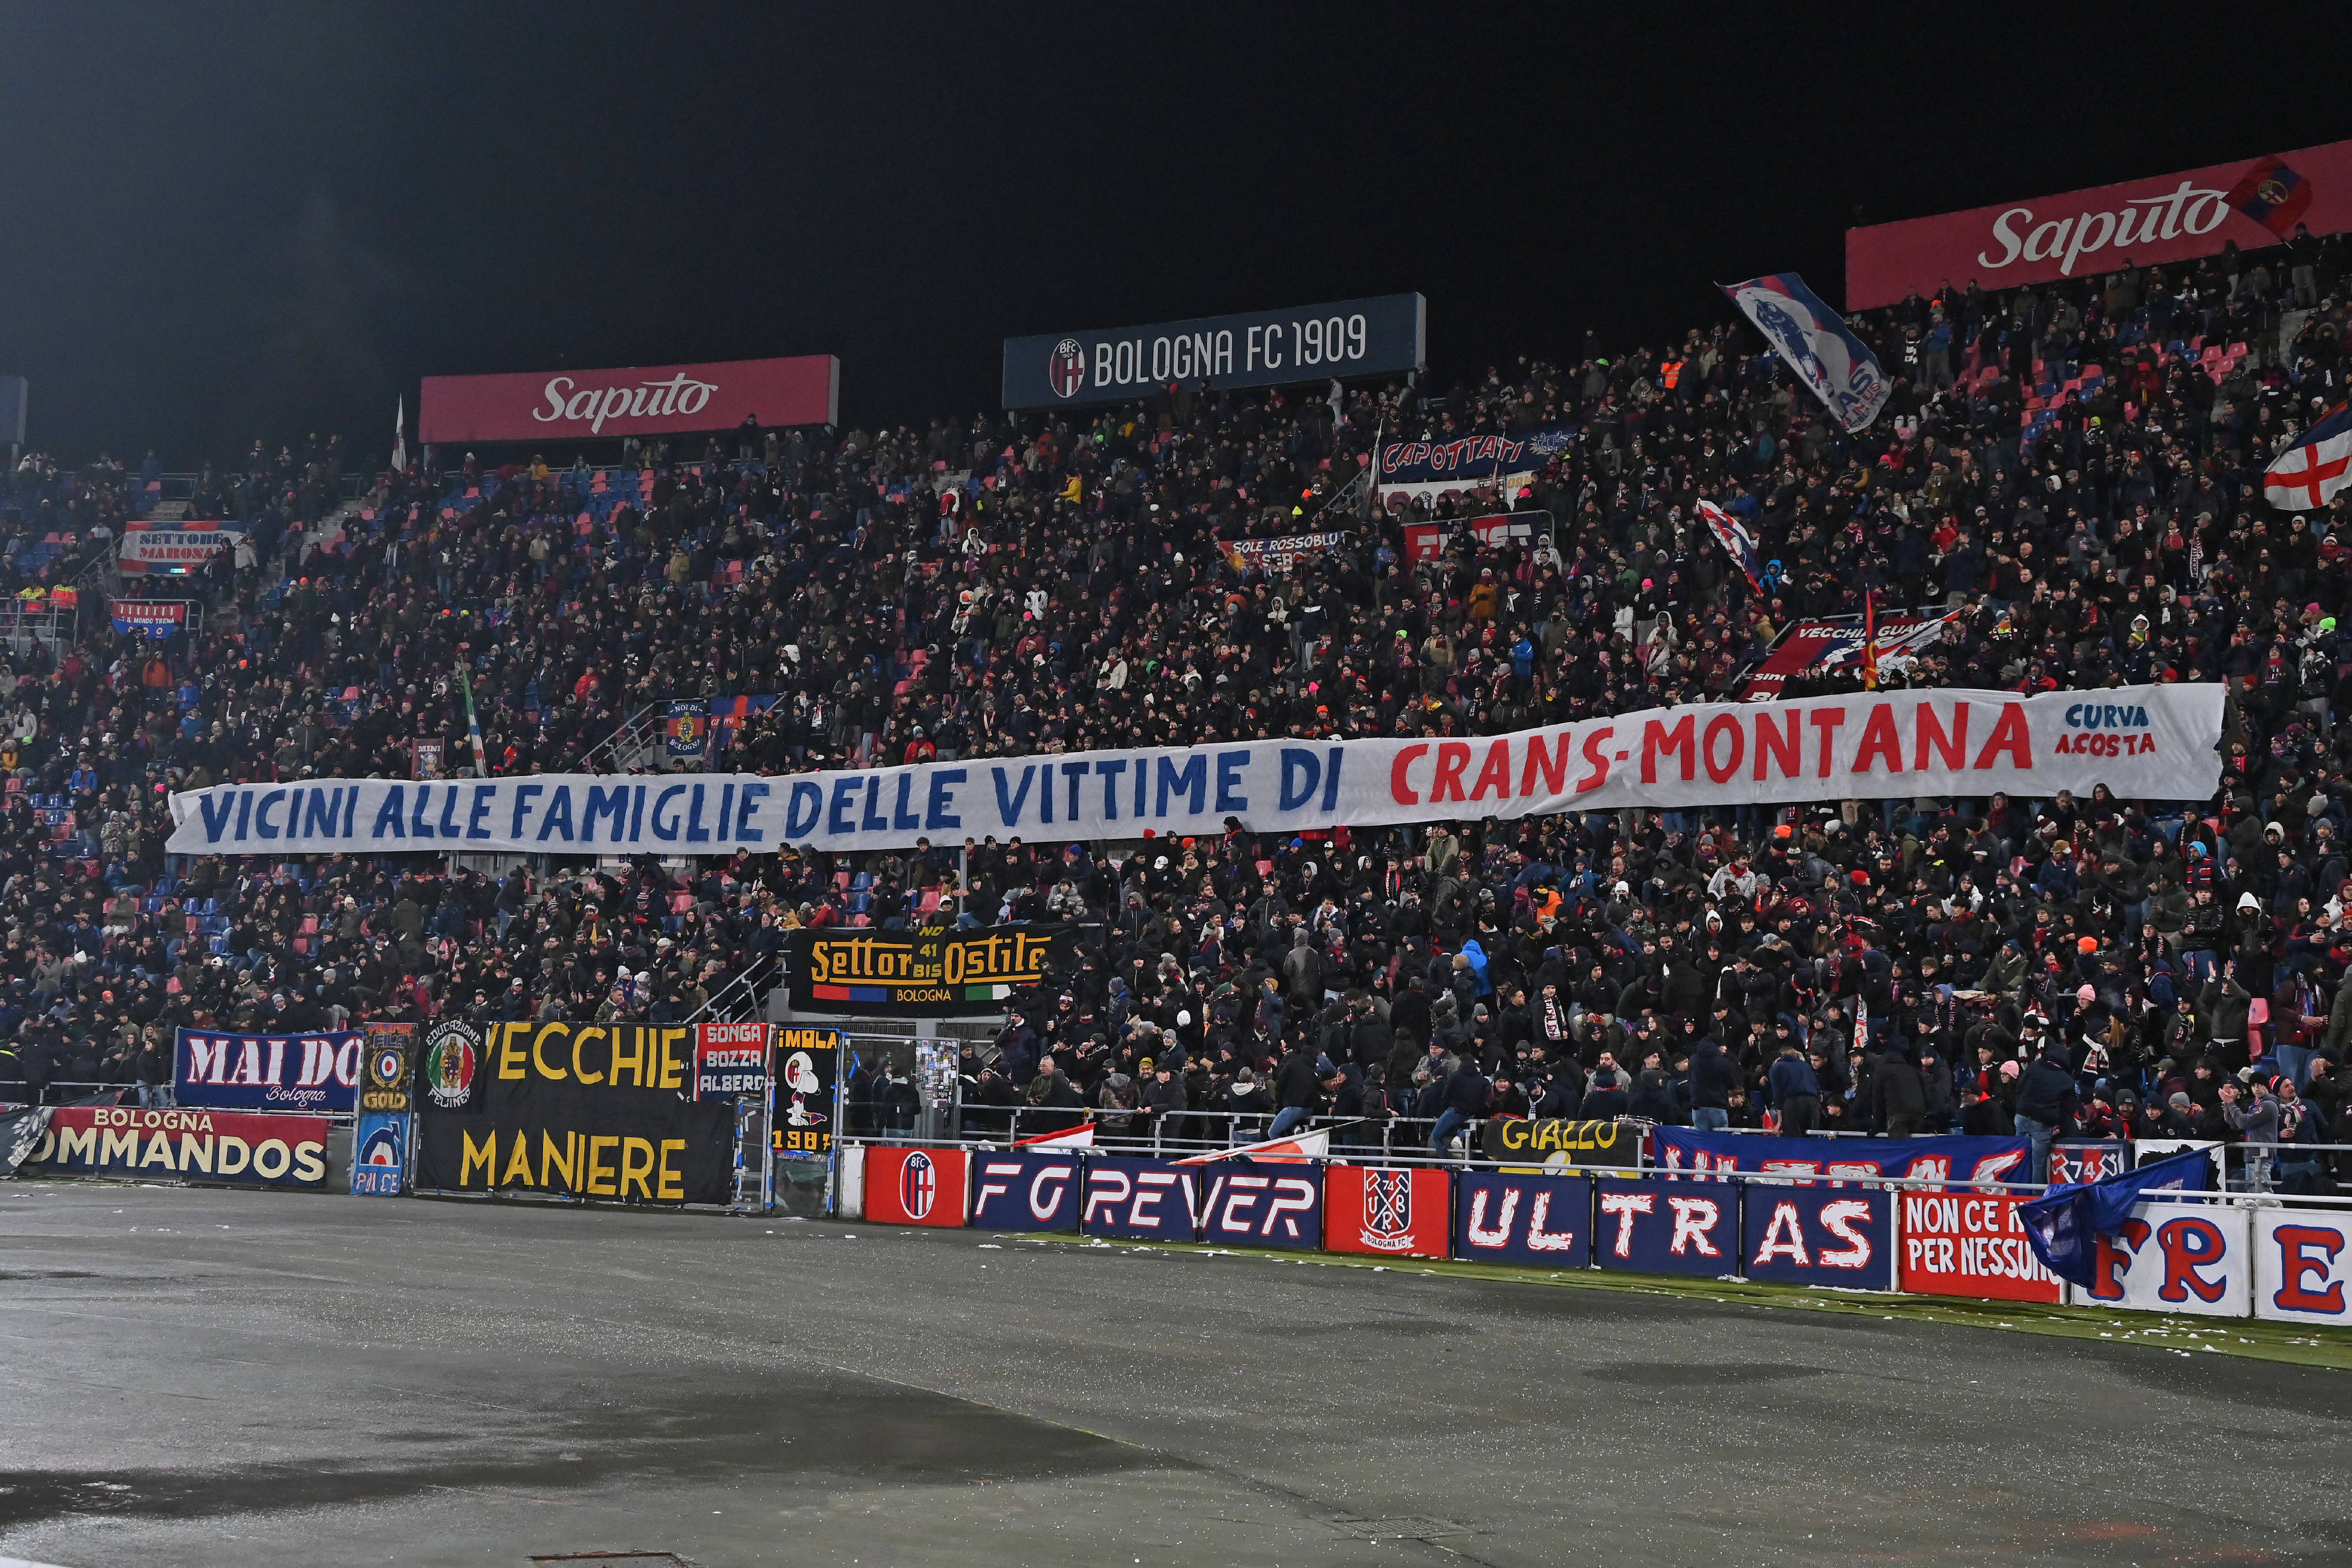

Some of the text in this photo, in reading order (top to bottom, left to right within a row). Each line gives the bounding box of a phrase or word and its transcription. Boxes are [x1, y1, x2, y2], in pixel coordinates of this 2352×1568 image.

[1978, 181, 2230, 276] Saputo
[1059, 341, 1076, 354] BFC
[1094, 314, 1366, 387] BOLOGNA FC 1909
[532, 372, 718, 435] Saputo
[1383, 435, 1525, 474] CAPOTTATI
[1233, 532, 1338, 554] SOLE ROSSOBLU
[675, 704, 688, 713] NOI
[2065, 704, 2149, 729] CURVA
[711, 717, 734, 726] GPPO
[669, 738, 701, 751] BOLOGNA
[2055, 732, 2156, 757] A.COSTA
[200, 701, 2033, 843] VICINI ALLE FAMIGLIE DELLE VITTIME DI CRANS-MONTANA
[919, 926, 945, 937] NO
[811, 933, 1049, 984] Settor Ostile
[920, 943, 937, 957] 41
[913, 963, 942, 978] BIS
[897, 989, 952, 1002] BOLOGNA
[373, 1034, 405, 1049] FILA
[426, 1020, 481, 1046] EDUCAZIONE
[706, 1025, 761, 1043] SONGA
[187, 1036, 287, 1086] MAI
[706, 1050, 761, 1067] BOZZA
[700, 1075, 765, 1092] ALBERO
[266, 1085, 327, 1107] Bologna
[363, 1092, 406, 1110] GOLD
[94, 1109, 214, 1133] BOLOGNA
[772, 1130, 831, 1151] 1987
[1502, 1119, 1620, 1150] GIALLO
[26, 1126, 326, 1182] OMMANDOS
[459, 1127, 686, 1200] MANIERE
[910, 1156, 926, 1168] BFC
[2069, 1160, 2096, 1179] 74
[1382, 1180, 1395, 1191] 74
[1368, 1194, 1406, 1229] U B R
[1907, 1197, 1959, 1234] NON
[1964, 1200, 1999, 1233] CE
[1467, 1186, 1873, 1269] ULTRAS
[1367, 1235, 1406, 1248] BOLOGNA FC
[1907, 1238, 1956, 1274] PER
